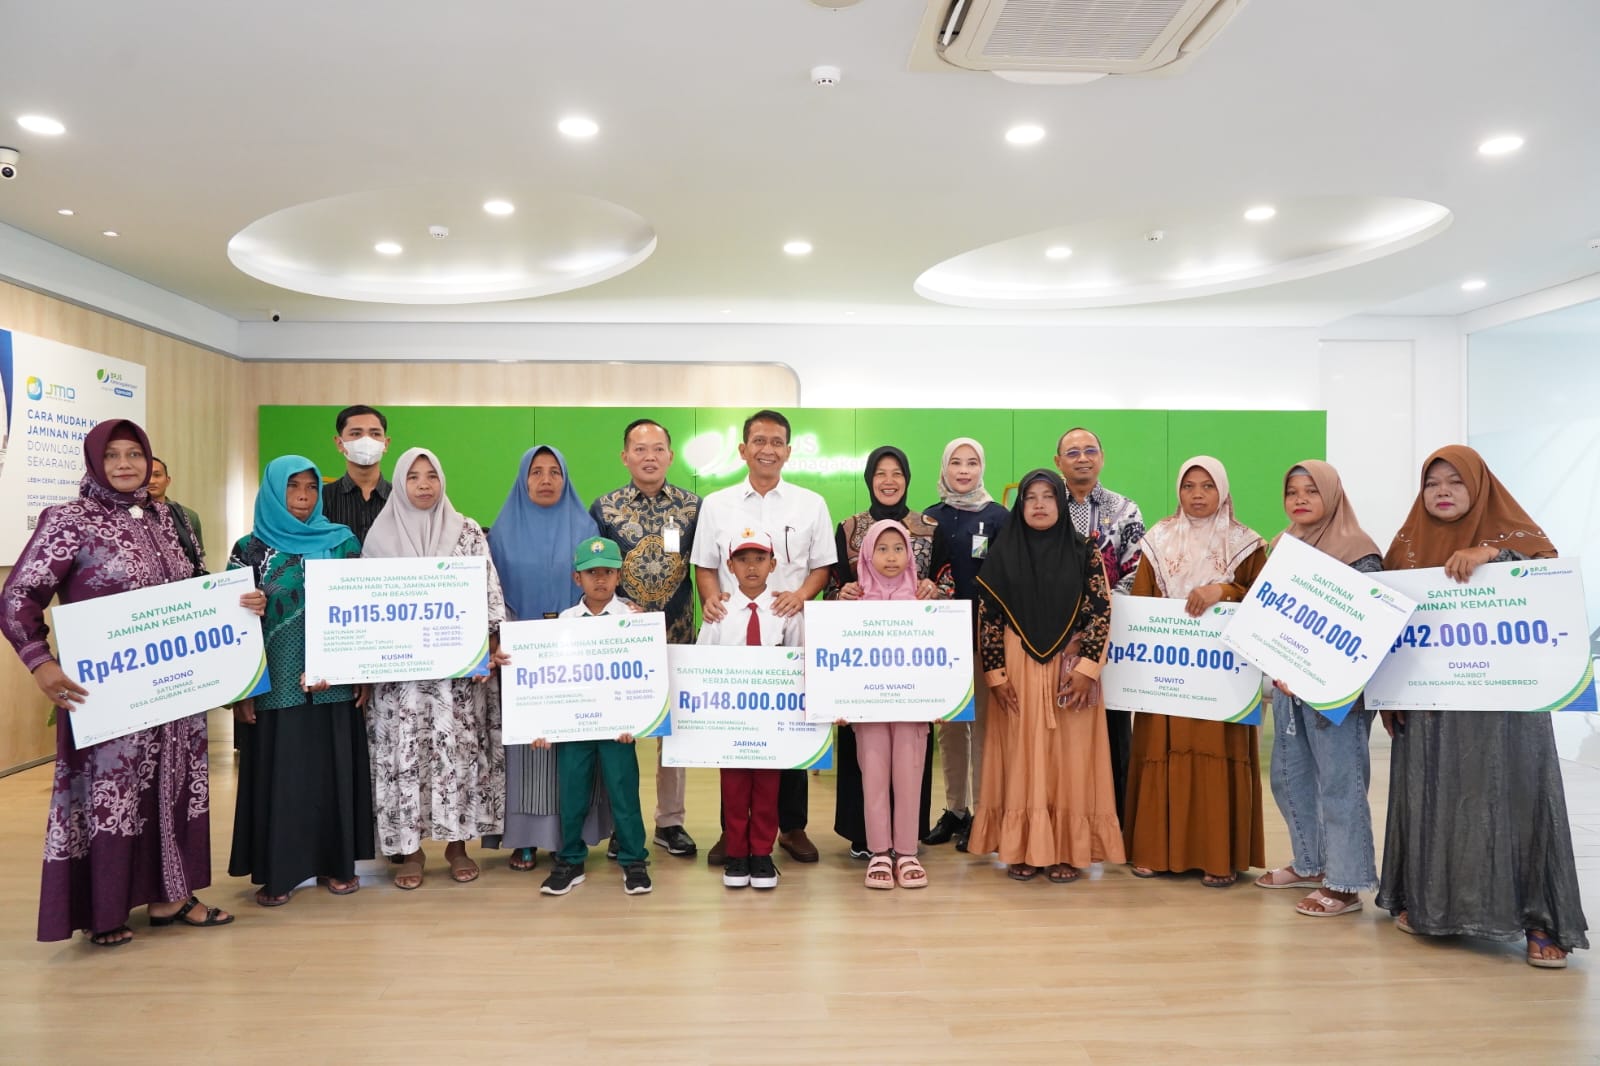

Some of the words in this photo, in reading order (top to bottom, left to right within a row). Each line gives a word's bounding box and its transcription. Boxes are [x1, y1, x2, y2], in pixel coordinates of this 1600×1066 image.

[45, 384, 76, 400] JMO
[27, 409, 54, 422] CARA
[56, 414, 87, 428] MUDAH
[27, 425, 68, 440] JAMINAN
[28, 440, 80, 456] DOWNLOAD
[28, 456, 76, 470] SEKARANG
[340, 575, 382, 583] SANTUNAN
[383, 574, 417, 582] JAMINAN
[418, 574, 458, 582] KEMATIAN,
[402, 582, 436, 590] JAMINAN
[390, 590, 428, 598] BEASISWA
[1312, 574, 1354, 601] SANTUNAN
[1427, 586, 1496, 599] SANTUNAN
[1290, 574, 1324, 598] JAMINAN
[1324, 593, 1366, 622] KEMATIAN
[1414, 602, 1457, 612] MINAN
[1460, 597, 1527, 610] KEMATIAN
[131, 601, 192, 622] SANTUNAN
[328, 602, 466, 627] Rp115.907.570,-
[107, 620, 160, 640] JAMINAN
[162, 607, 216, 627] KEMATIAN
[1148, 616, 1201, 626] SANTUNAN
[1256, 581, 1368, 664] Rp42.000.000,-
[842, 630, 884, 638] JAMINAN
[886, 629, 935, 637] KEMATIAN
[1128, 624, 1170, 635] JAMINAN
[1172, 628, 1222, 638] KEMATIAN
[512, 642, 559, 652] SANTUNAN
[599, 636, 654, 645] KECELAKAAN
[586, 647, 629, 656] BEASISWA
[77, 624, 248, 684] Rp42.000.000,-
[816, 646, 960, 672] Rp42.000.000,-
[676, 668, 724, 676] SANTUNAN
[724, 668, 763, 676] JAMINAN
[1448, 661, 1490, 670] DUMADI
[152, 669, 194, 686] SARJONO
[516, 660, 655, 688] Rp152.500.000,-
[1154, 676, 1185, 685] SUWITO
[751, 678, 795, 686] BEASISWA
[130, 699, 149, 710] DESA
[149, 690, 182, 704] CARUBAN
[574, 712, 602, 720] SUKARI
[732, 740, 768, 748] JARIMAN
